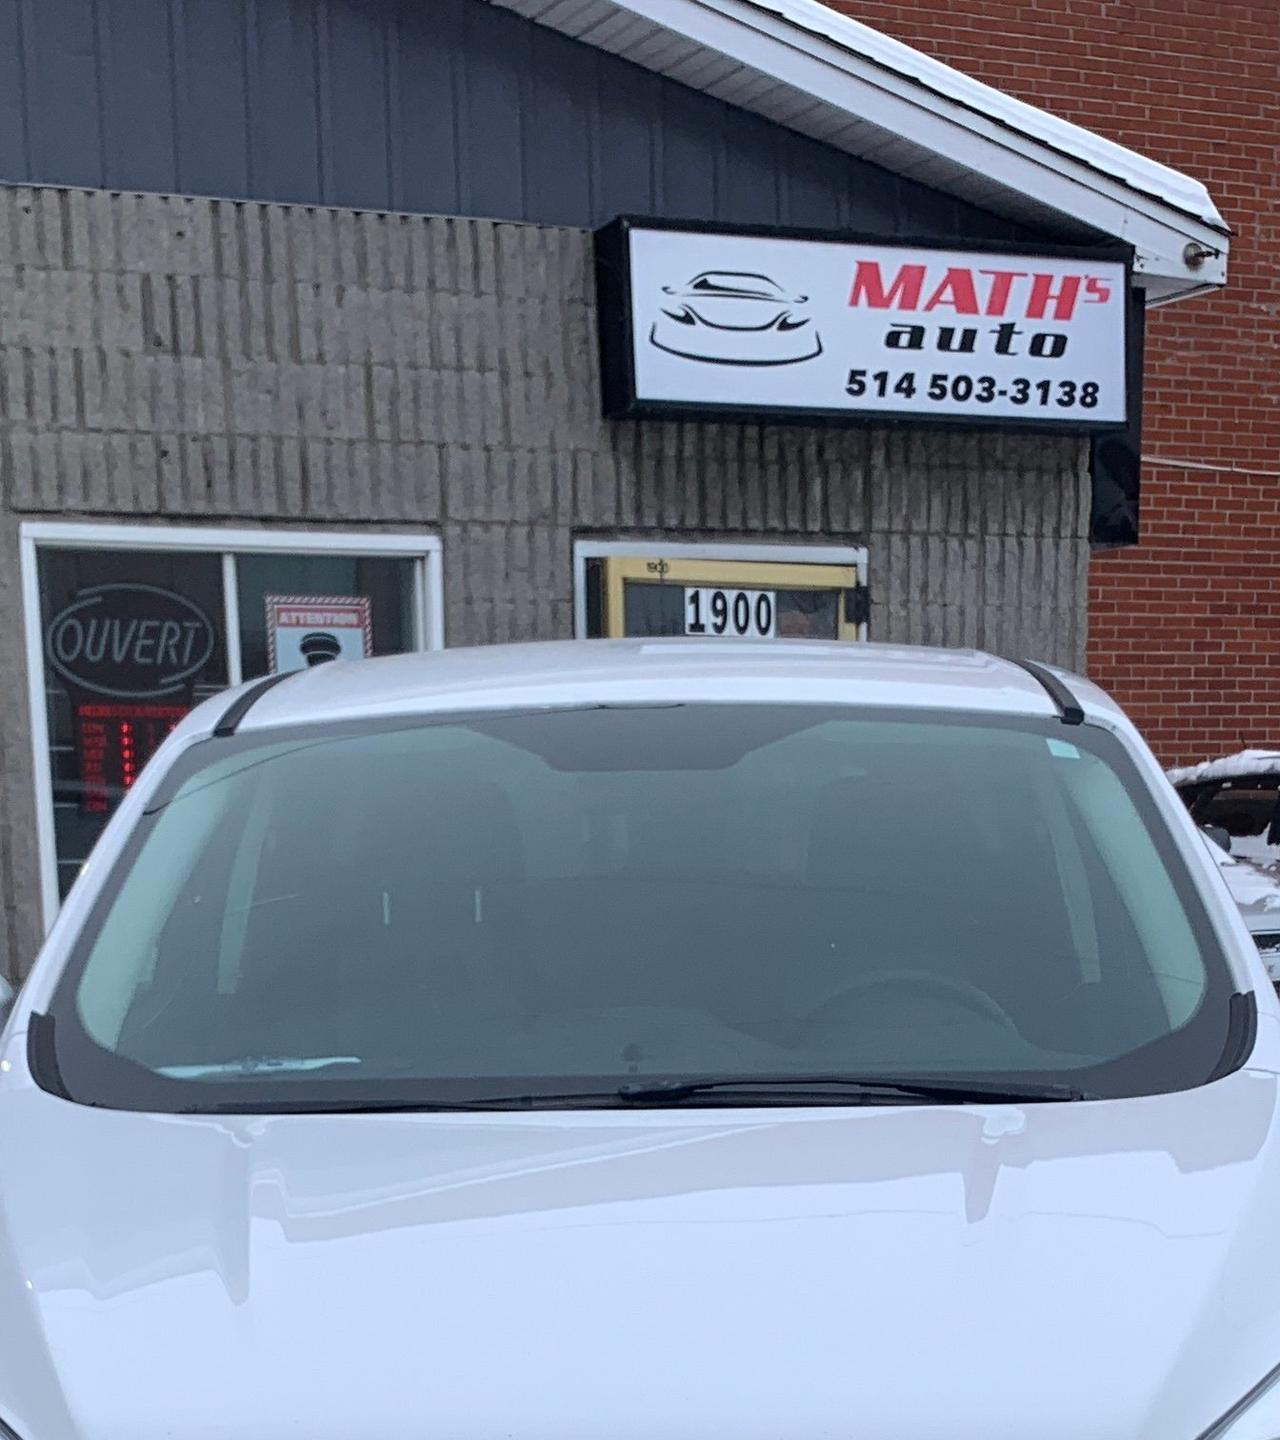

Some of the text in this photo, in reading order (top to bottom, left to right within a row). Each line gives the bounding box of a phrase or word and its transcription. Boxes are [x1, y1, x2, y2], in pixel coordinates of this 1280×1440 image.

[884, 322, 1069, 359] auto
[845, 369, 1100, 409] 514 503-3138
[279, 611, 359, 626] ATTENTION
[687, 589, 773, 636] 1900
[56, 618, 203, 667] OUVERT
